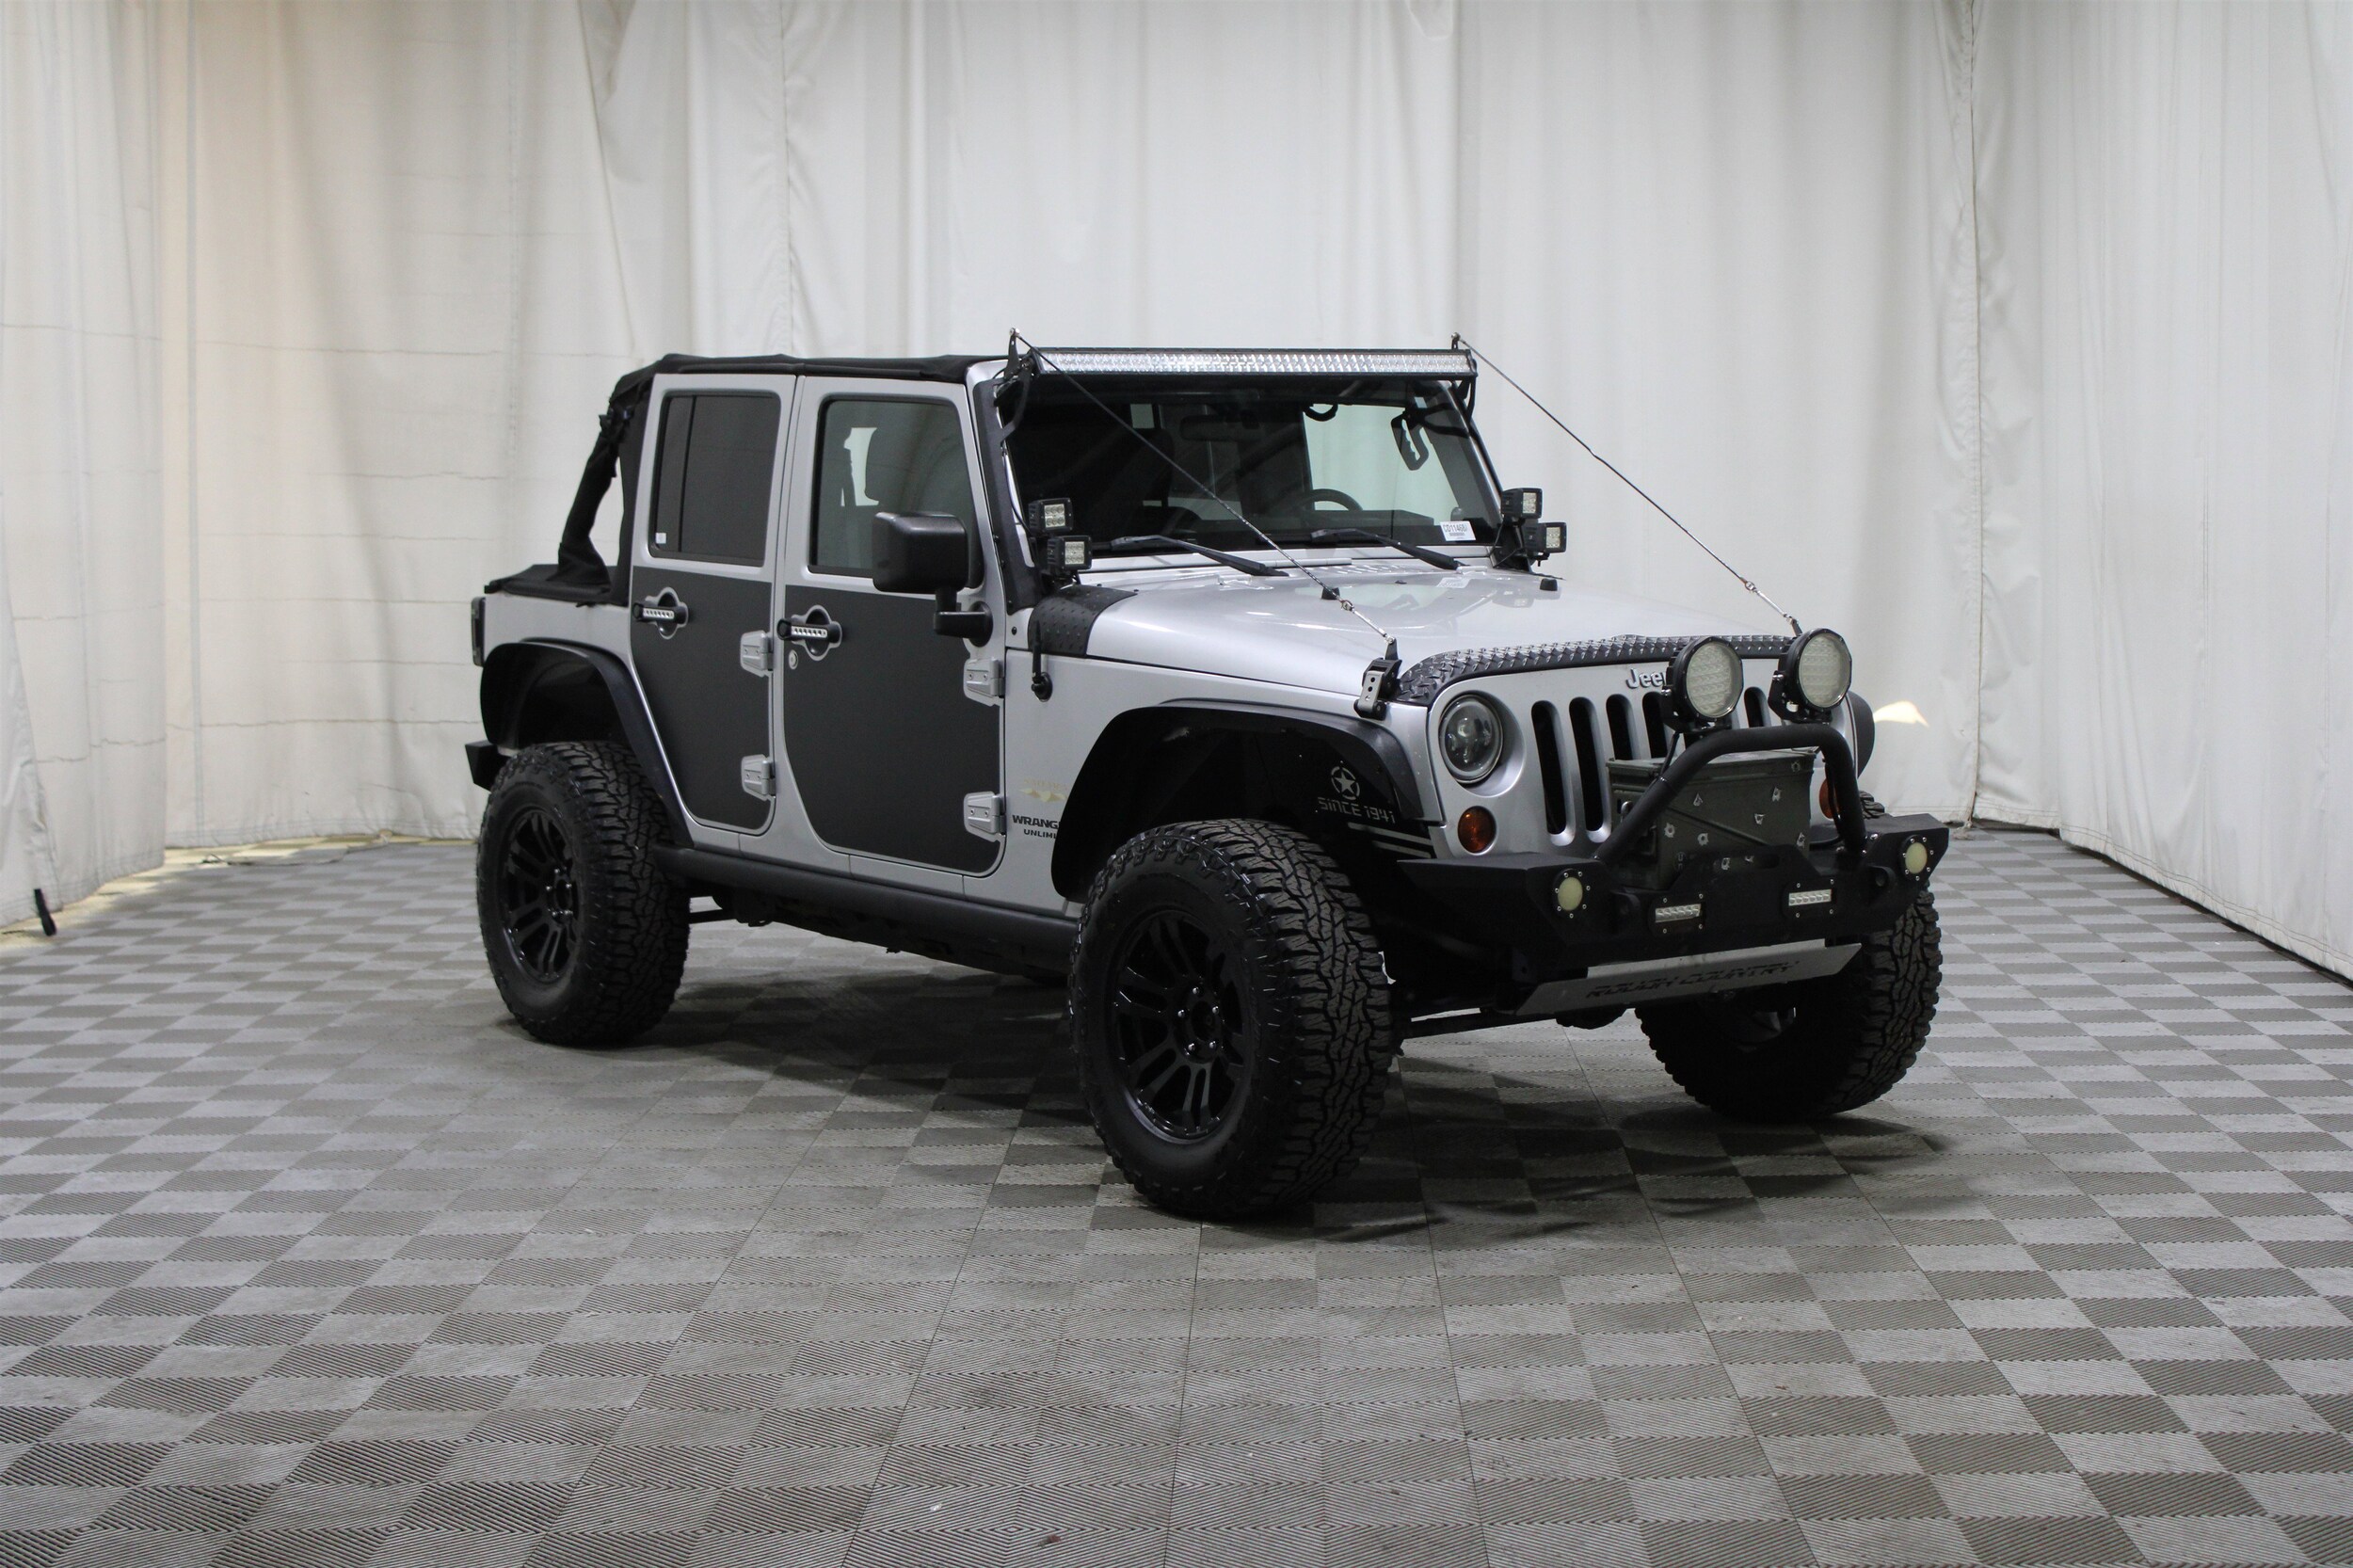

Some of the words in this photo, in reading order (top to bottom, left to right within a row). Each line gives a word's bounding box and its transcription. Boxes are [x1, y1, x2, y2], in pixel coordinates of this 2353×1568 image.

[1012, 815, 1060, 828] WRANG
[1364, 806, 1396, 824] 1941
[1585, 976, 1678, 998] ROUGH
[1680, 961, 1800, 984] COUNTRY
